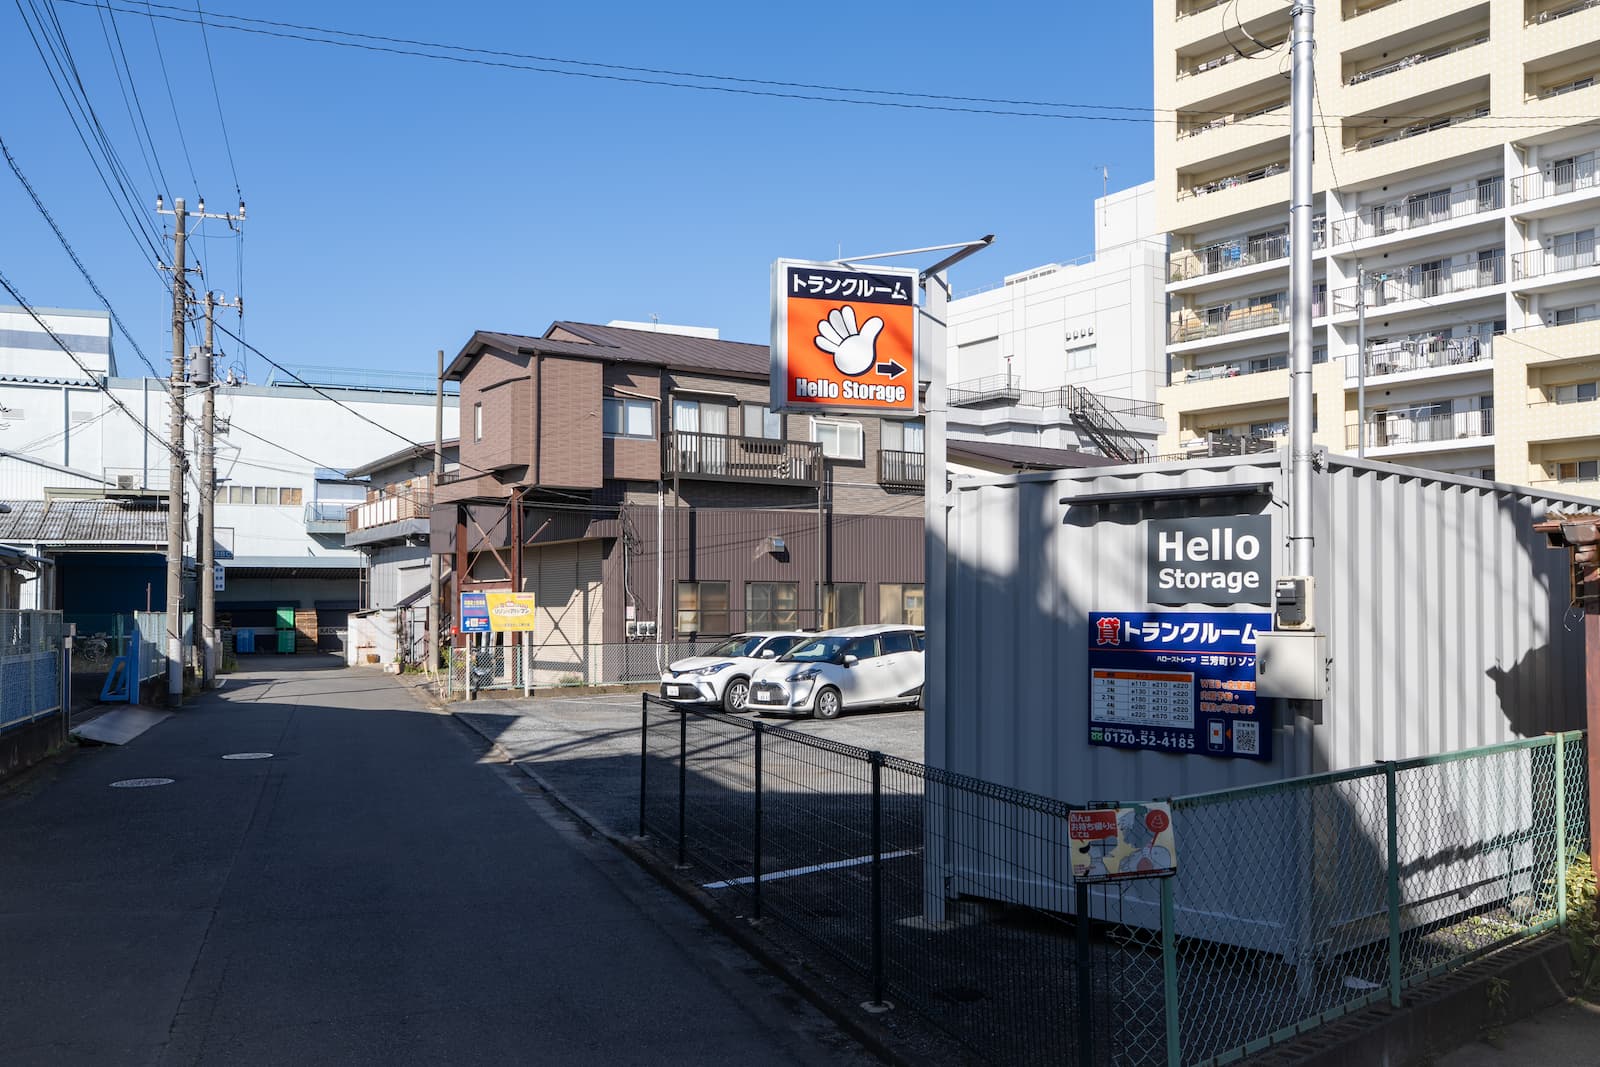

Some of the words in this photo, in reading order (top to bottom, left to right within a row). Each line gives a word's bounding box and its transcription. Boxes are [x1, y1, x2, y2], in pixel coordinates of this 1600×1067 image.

[793, 273, 908, 301] トランクルーム
[795, 378, 839, 399] Hello
[842, 380, 906, 403] Storage
[1158, 528, 1260, 562] Hello
[1158, 568, 1260, 594] Storage
[1104, 731, 1195, 749] 0120-52-4185
